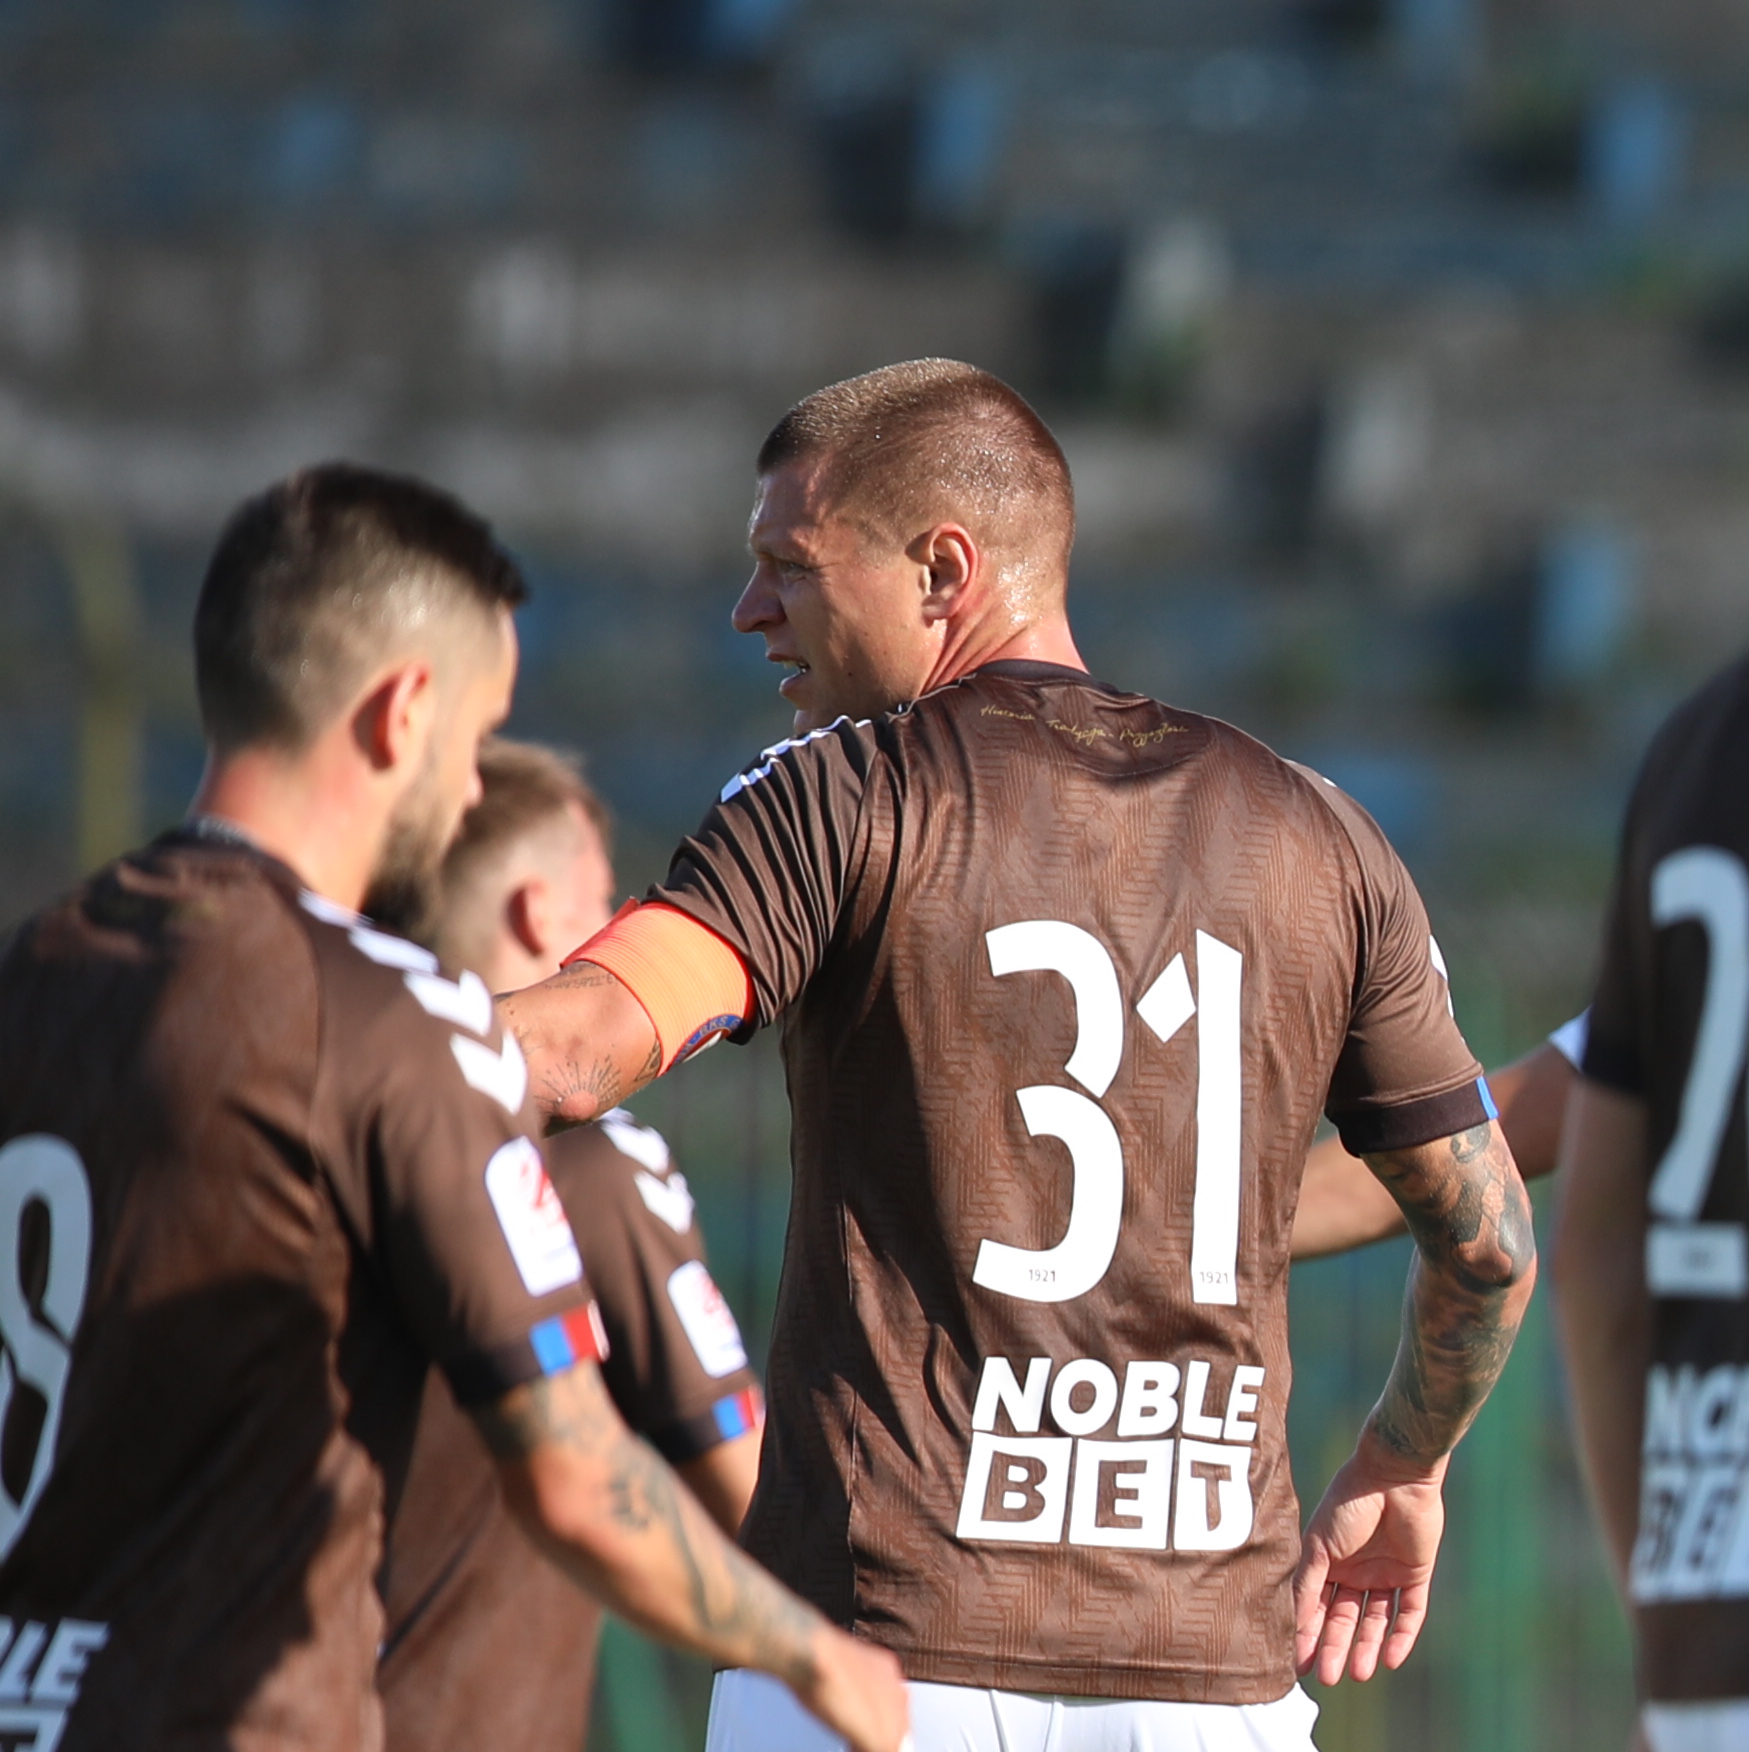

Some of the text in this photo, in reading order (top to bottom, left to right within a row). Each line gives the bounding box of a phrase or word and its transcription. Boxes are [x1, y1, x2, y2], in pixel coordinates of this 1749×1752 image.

[973, 919, 1243, 1305] 31
[1028, 1269, 1057, 1283] 1921
[1199, 1271, 1230, 1284] 1921
[971, 1356, 1266, 1442] NOBLE
[970, 1443, 1242, 1540] BET
